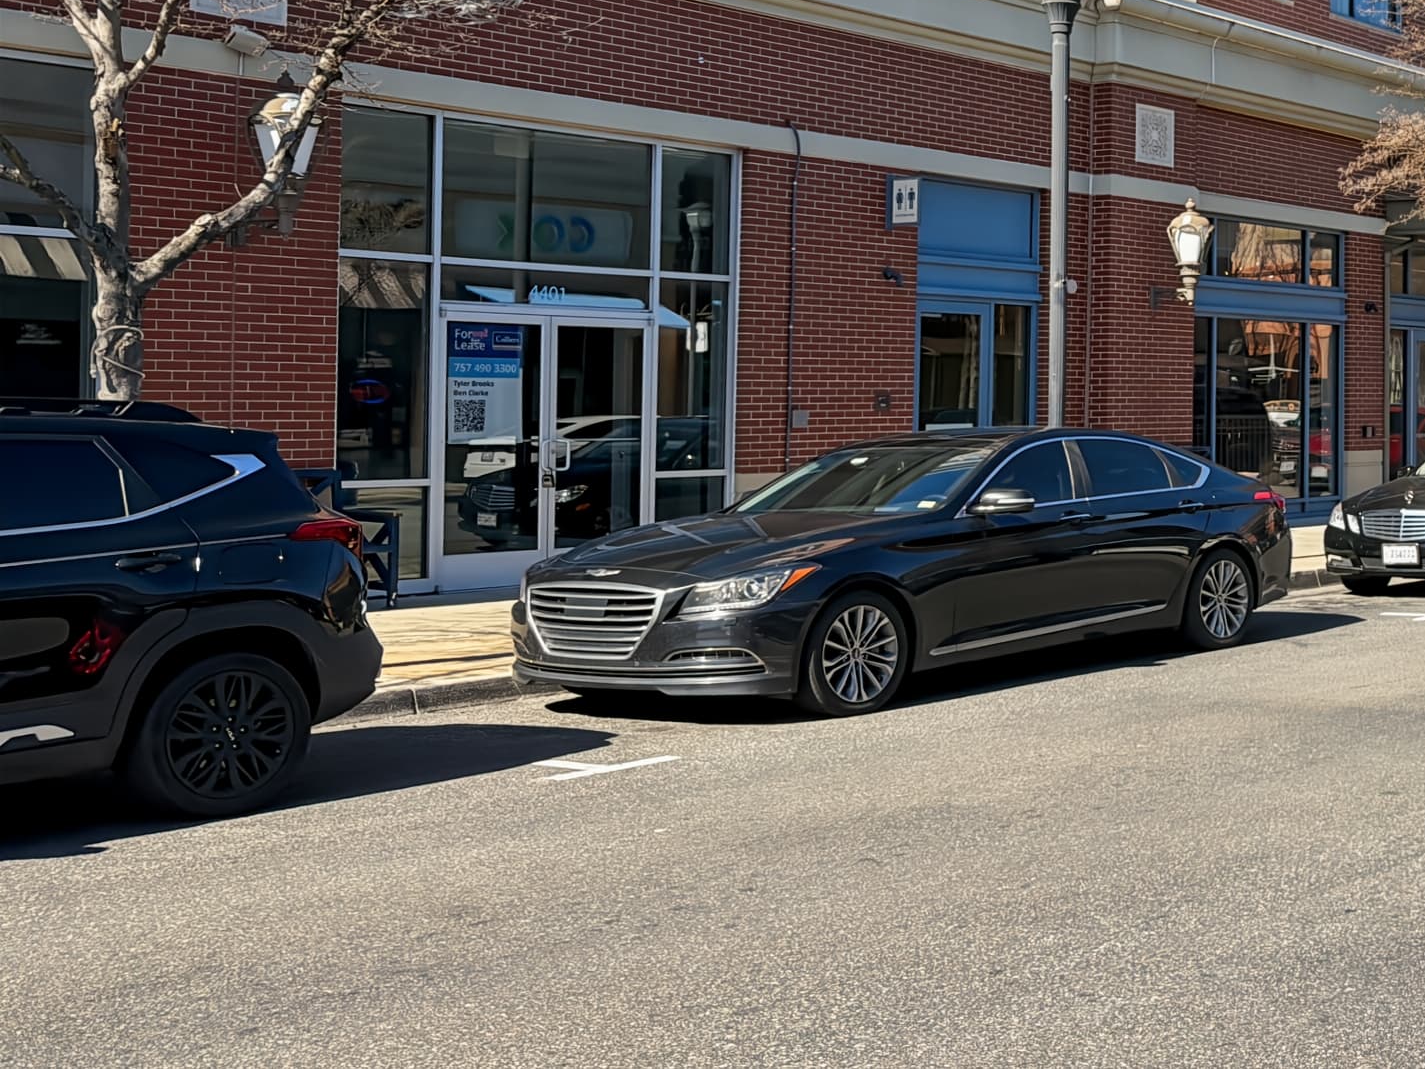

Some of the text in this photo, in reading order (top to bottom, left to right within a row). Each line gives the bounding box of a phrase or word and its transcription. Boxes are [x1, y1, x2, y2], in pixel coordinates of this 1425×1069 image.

[528, 284, 566, 301] 4401
[454, 328, 472, 339] For
[454, 339, 486, 351] Lease
[454, 362, 517, 373] 757 490 3300
